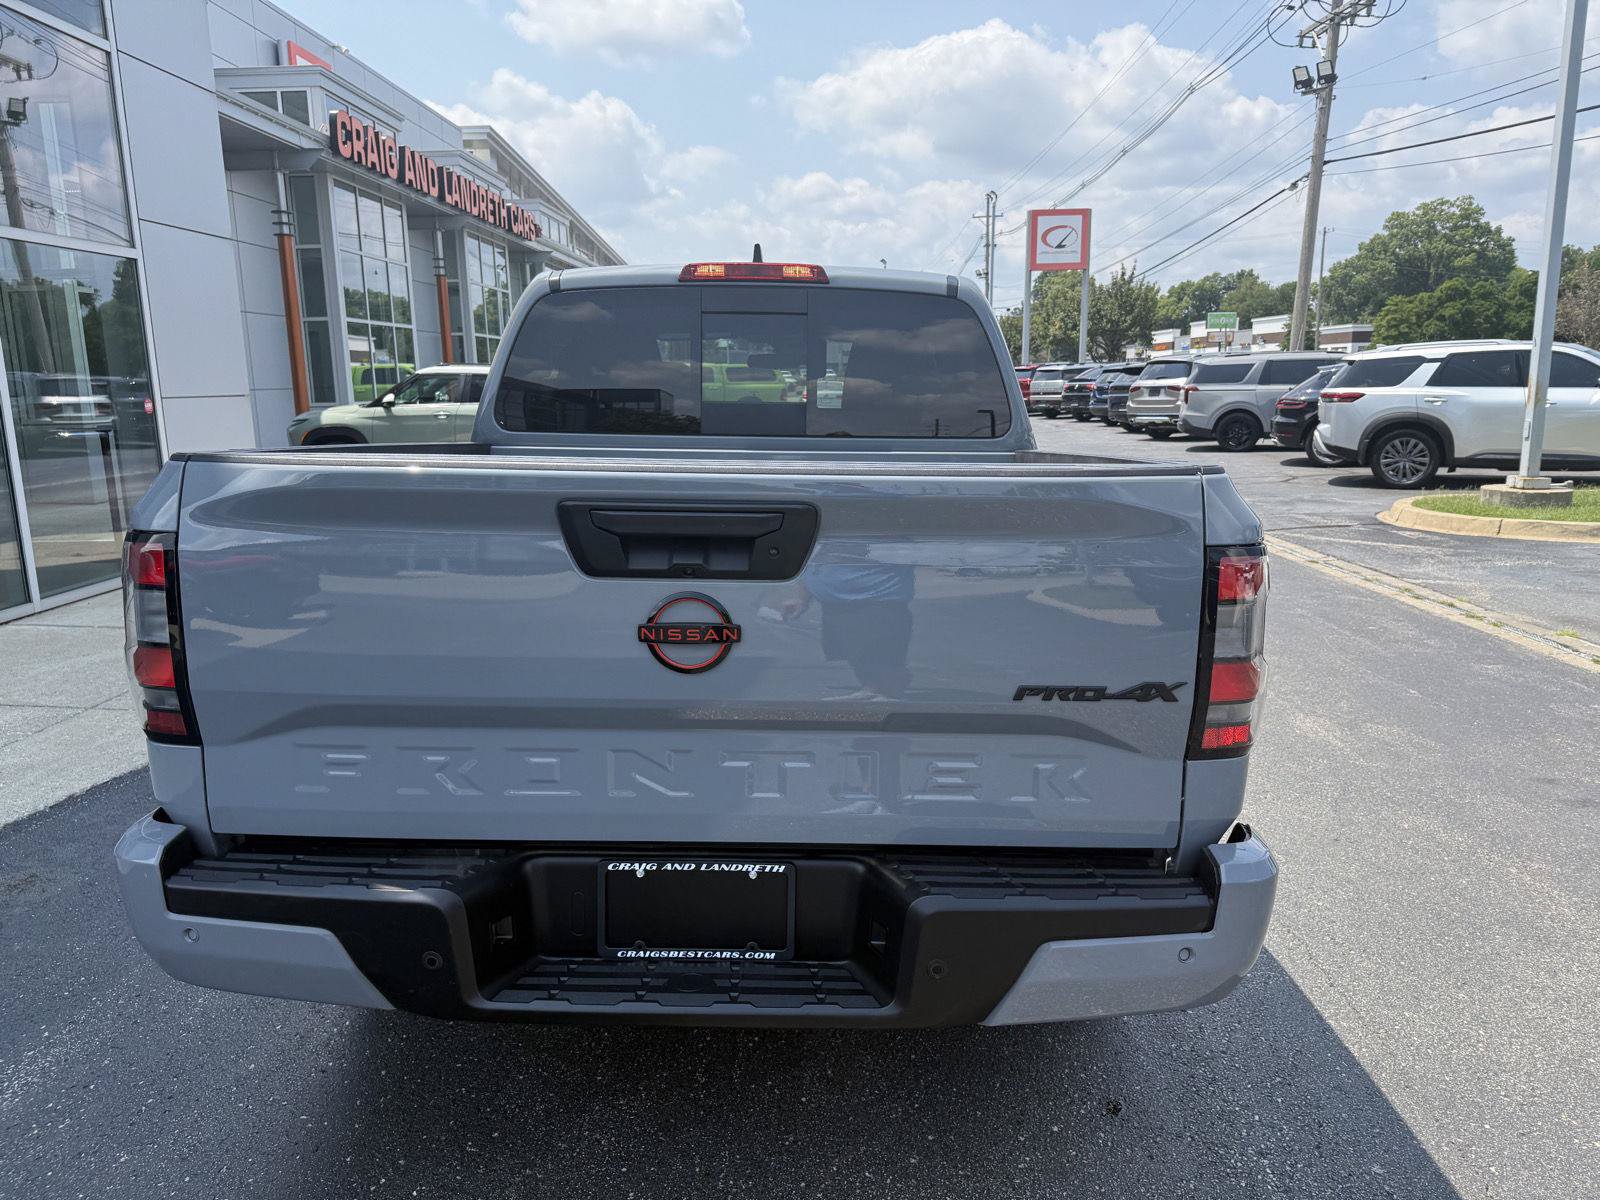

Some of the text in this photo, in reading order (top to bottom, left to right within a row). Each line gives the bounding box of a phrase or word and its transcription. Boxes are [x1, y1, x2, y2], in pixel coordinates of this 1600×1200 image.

[336, 110, 536, 241] CRAIG AND LANDRETH CARS
[641, 628, 738, 641] NISSAN
[294, 742, 1092, 802] FRONTIER
[607, 863, 786, 873] CRAIG AND LANDRETH
[617, 950, 776, 960] CRAIGSBESTCARS.COM
